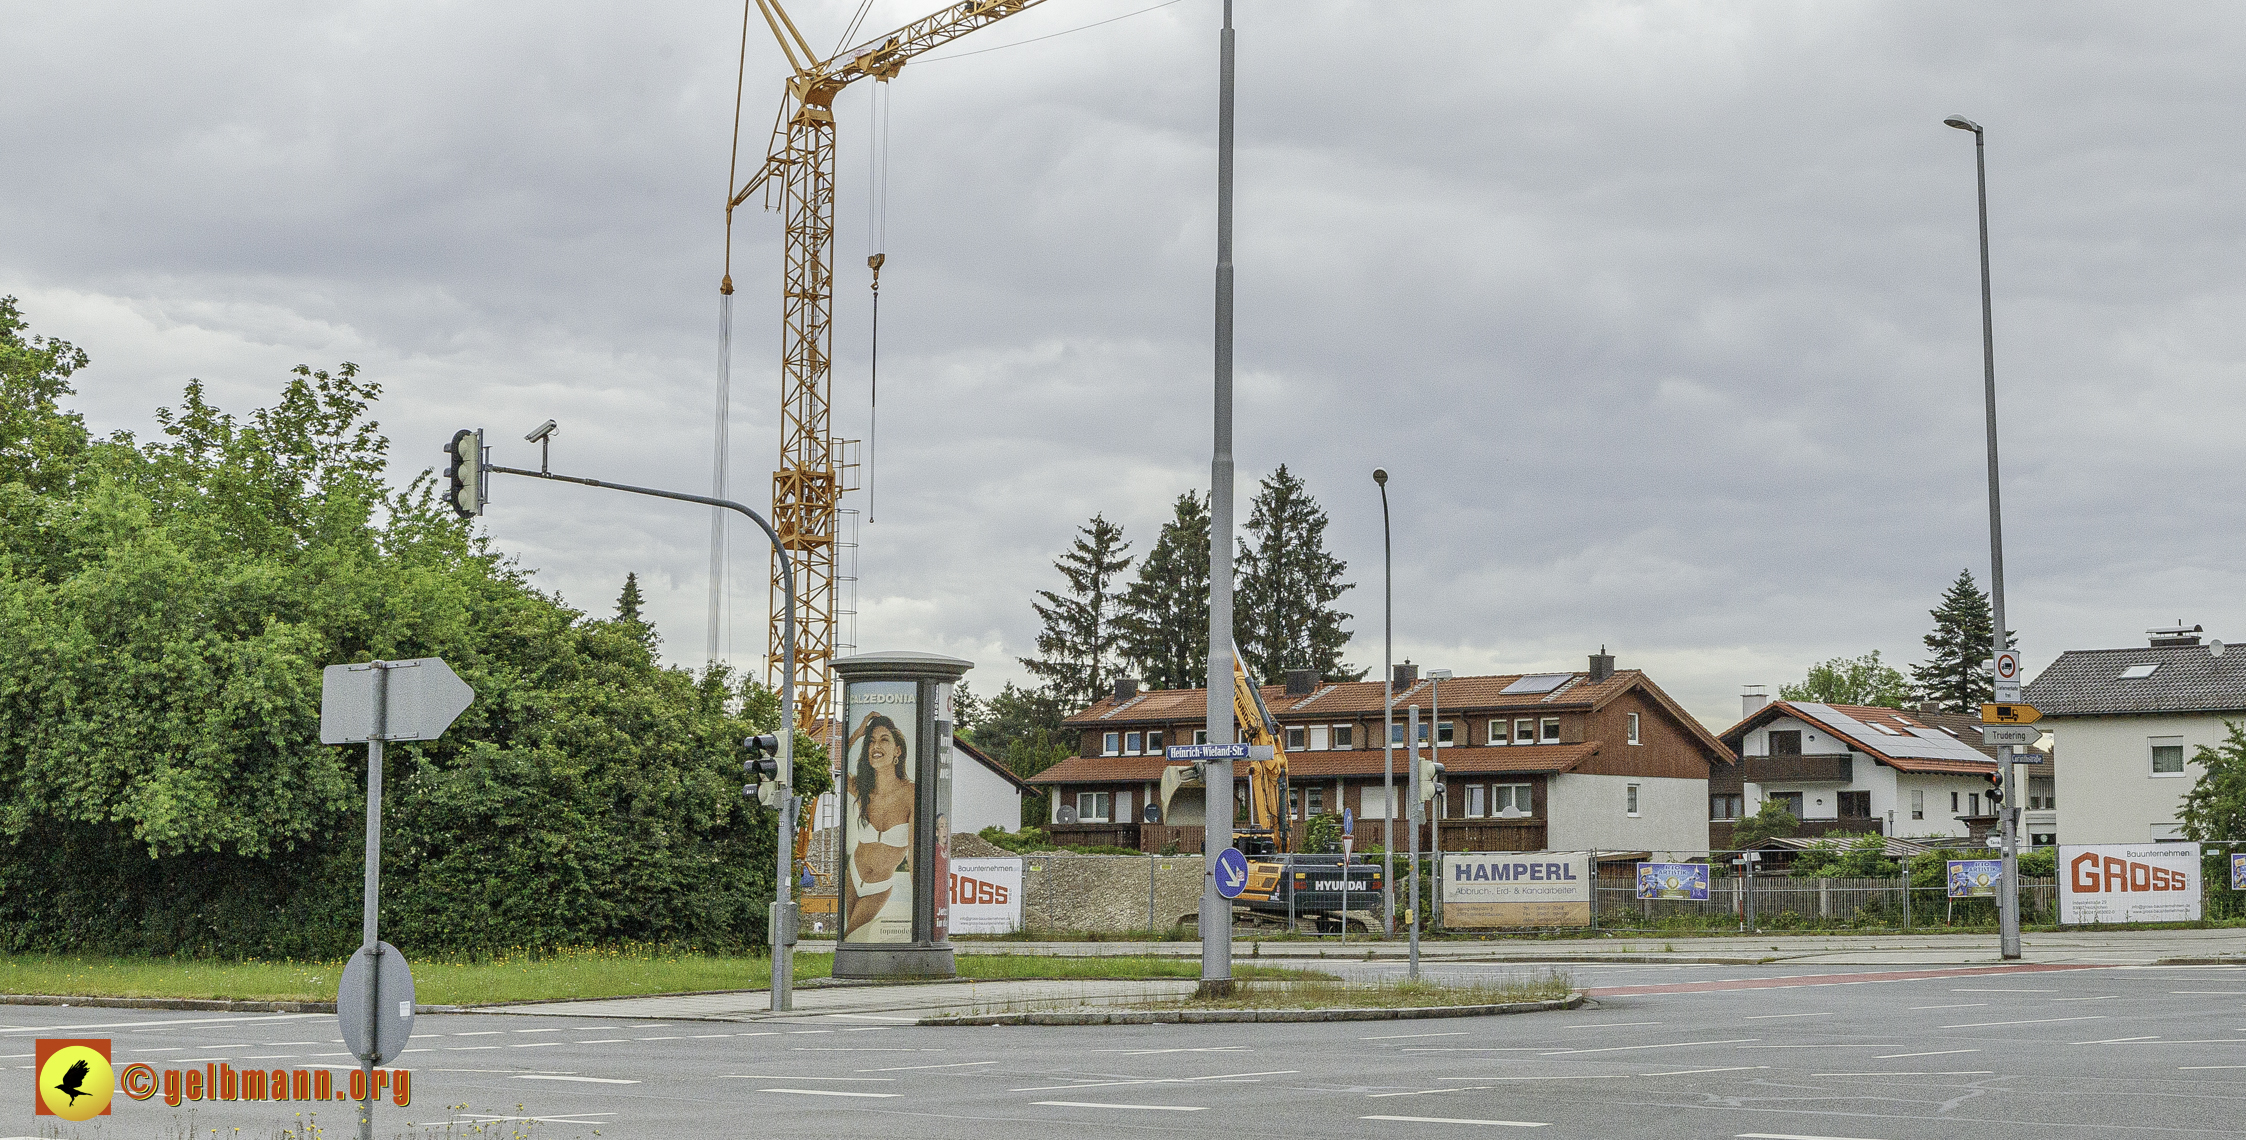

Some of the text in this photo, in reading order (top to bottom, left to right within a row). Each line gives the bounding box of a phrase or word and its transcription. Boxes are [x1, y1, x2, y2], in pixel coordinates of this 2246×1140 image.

[1992, 731, 2026, 742] Trudering
[1170, 745, 1244, 758] Heinrich-Wieland-Str.
[2126, 850, 2190, 858] Bauunternehmen
[1455, 862, 1577, 881] HAMPERL
[2071, 852, 2186, 893] GROSS
[1315, 880, 1367, 891] HYUNDAI
[1455, 887, 1577, 895] Abbruch-, Erd- & Kanalarbeiten
